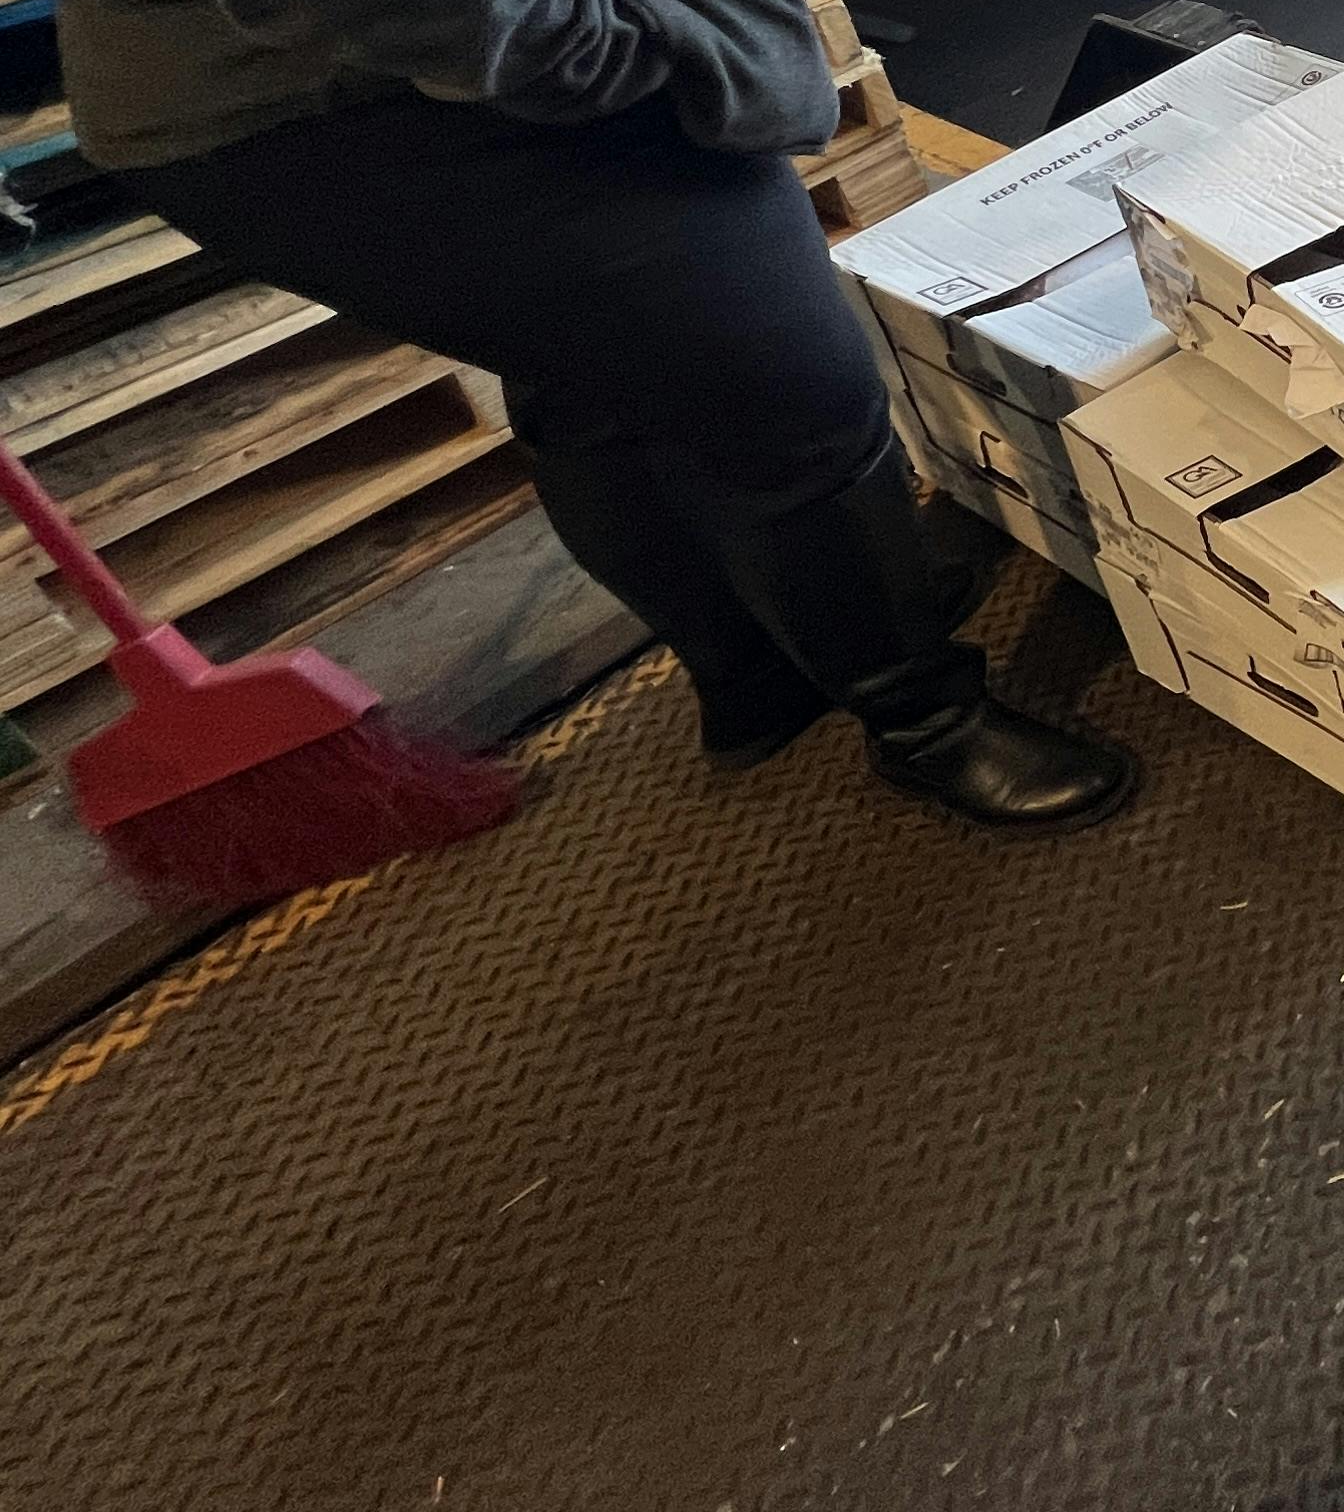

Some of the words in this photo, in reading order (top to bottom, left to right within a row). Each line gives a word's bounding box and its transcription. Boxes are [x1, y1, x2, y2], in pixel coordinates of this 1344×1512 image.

[980, 183, 1019, 206] KEEP
[1020, 151, 1082, 186] FROZEN
[1104, 128, 1129, 143] OR
[1124, 101, 1174, 131] BELOW
